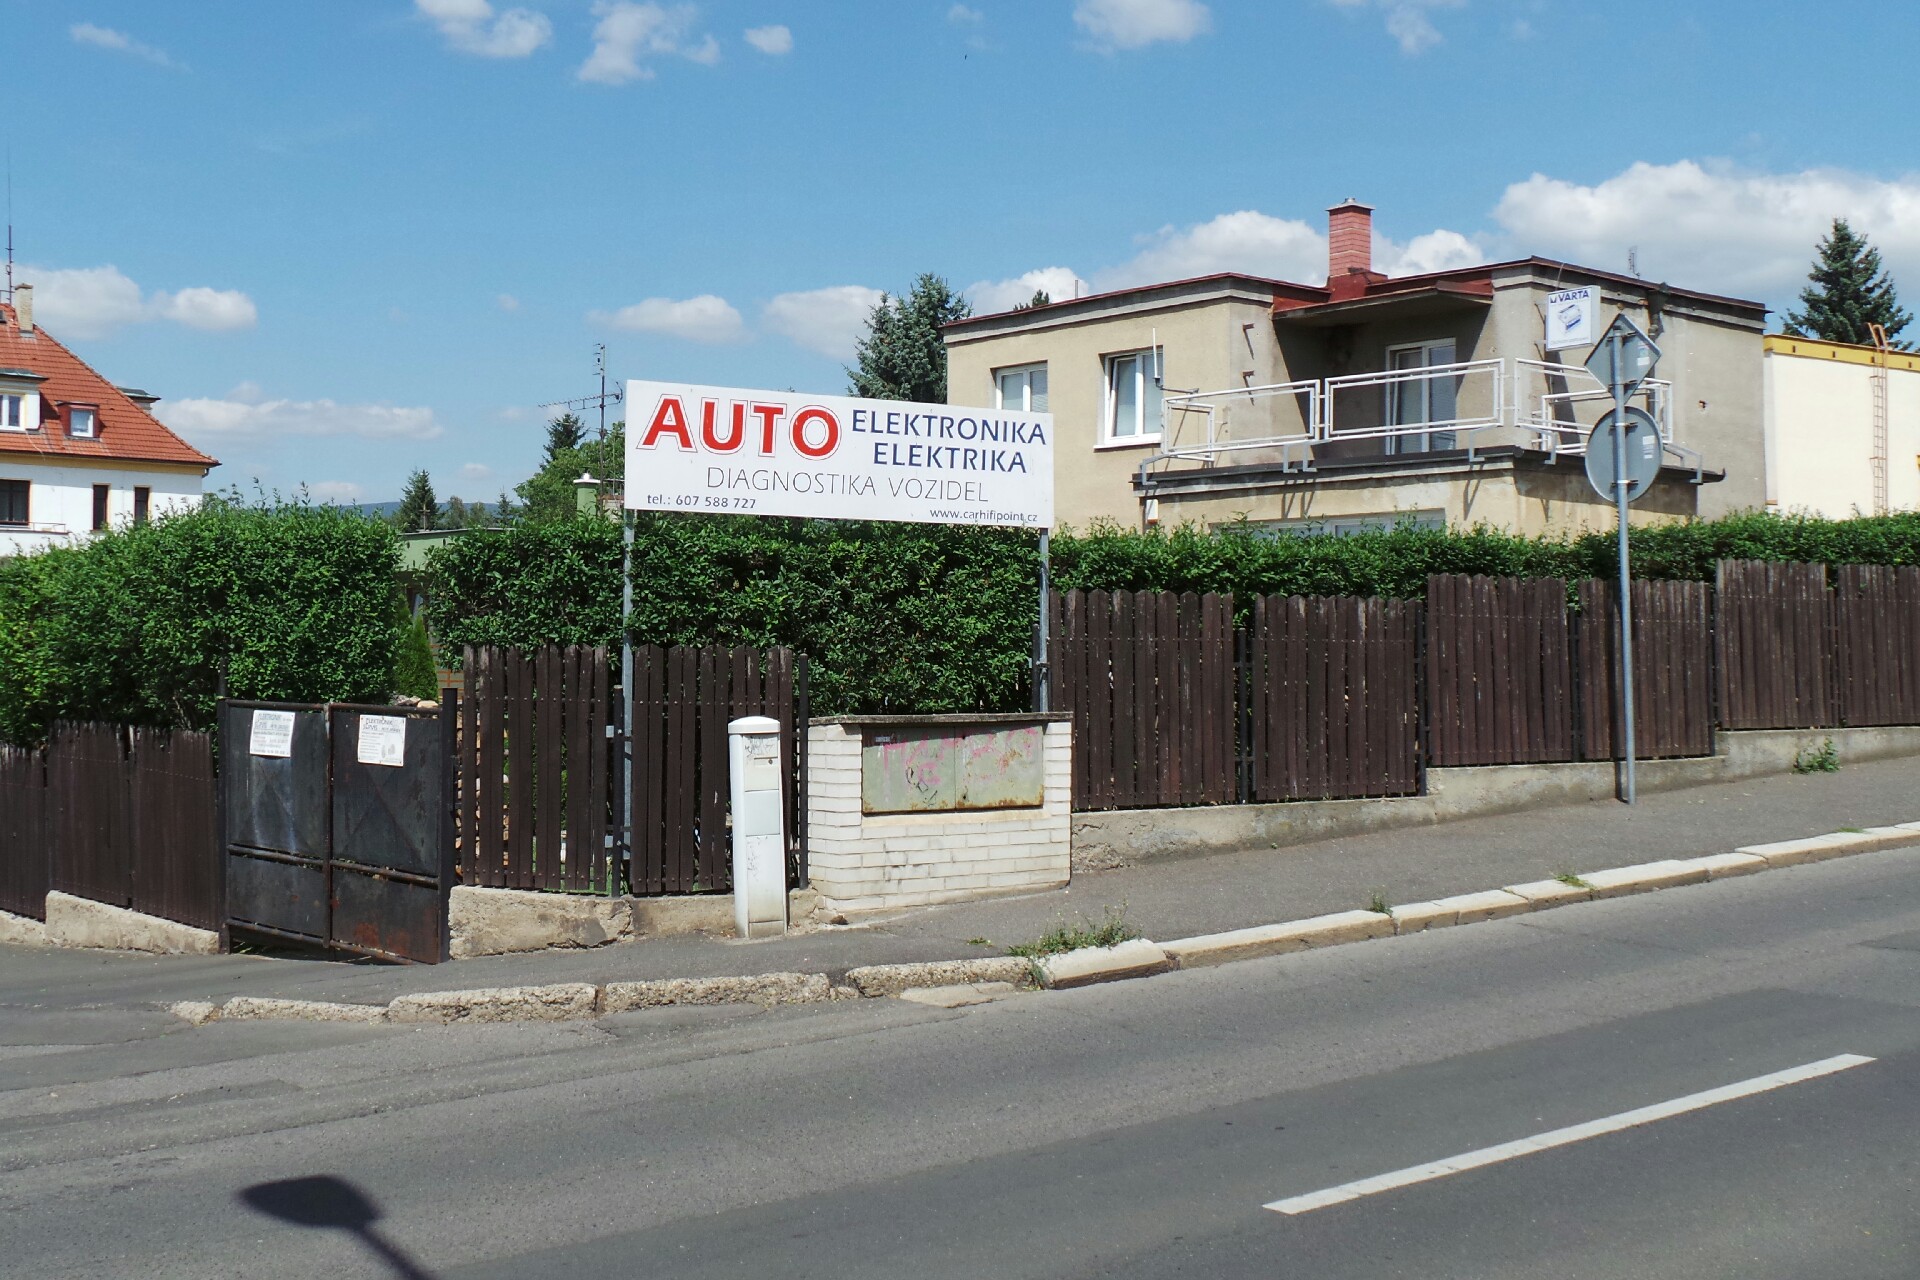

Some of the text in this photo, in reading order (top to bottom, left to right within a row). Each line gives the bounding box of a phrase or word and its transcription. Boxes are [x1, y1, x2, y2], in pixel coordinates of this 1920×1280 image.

[1558, 290, 1588, 302] VARTA
[638, 394, 1046, 460] AUTO ELEKTRONIKA
[873, 442, 1027, 474] ELEKTRIKA
[706, 466, 988, 502] DIAGNOSTIKA VOZIDEL
[647, 493, 756, 509] tel.: 607 588 727
[930, 509, 1037, 523] www.carhifipoint.cz
